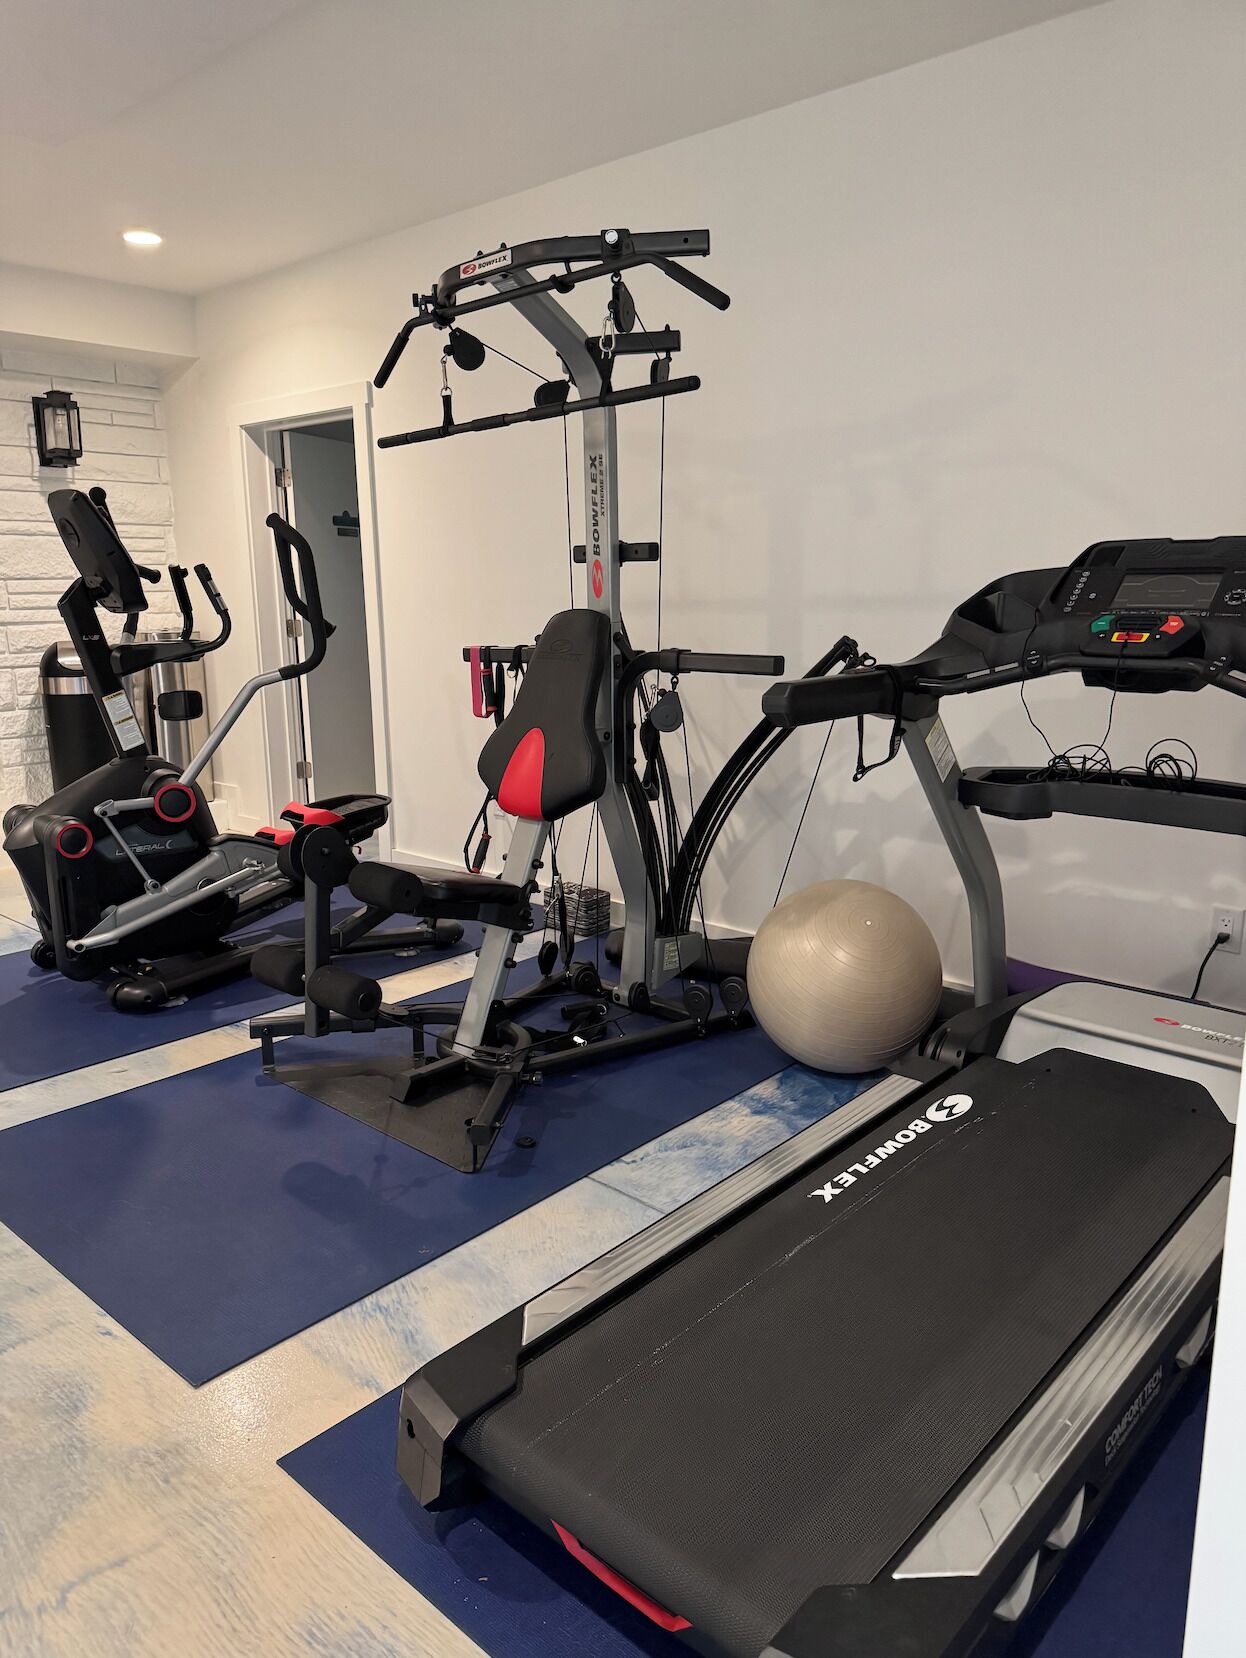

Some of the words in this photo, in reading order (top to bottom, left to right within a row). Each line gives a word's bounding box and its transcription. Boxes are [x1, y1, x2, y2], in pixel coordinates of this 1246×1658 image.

[478, 255, 507, 270] BOWFLEX
[589, 454, 601, 557] BOWFLEX
[115, 842, 165, 856] LTERAL
[1180, 1024, 1244, 1041] BOWFLE
[810, 1118, 934, 1204] BOWFLEX
[1105, 1391, 1145, 1454] COMFORT
[1143, 1364, 1163, 1400] TECH
